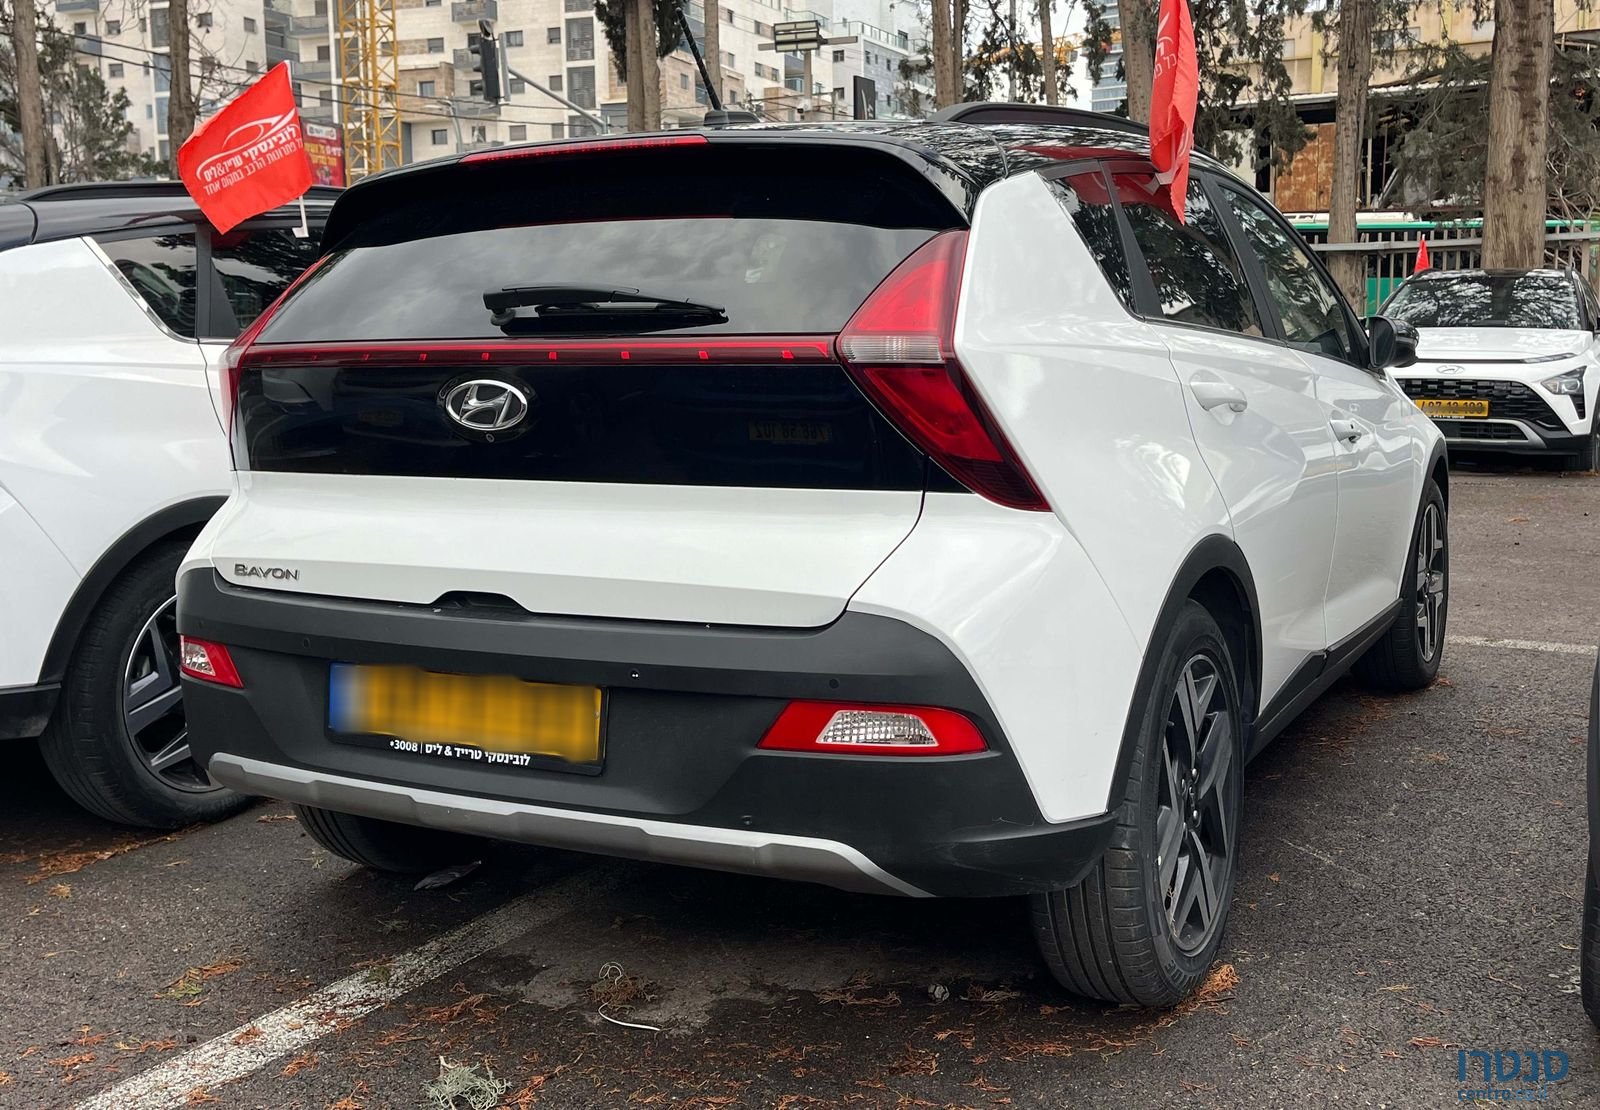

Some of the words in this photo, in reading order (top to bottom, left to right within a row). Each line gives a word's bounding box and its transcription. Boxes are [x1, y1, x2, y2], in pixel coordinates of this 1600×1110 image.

[242, 125, 297, 161] לובינסקי
[267, 142, 297, 162] פתרונות
[244, 157, 267, 176] הרכב
[203, 179, 222, 196] אחד
[221, 169, 245, 189] במקום
[234, 563, 299, 580] BAYON
[425, 743, 442, 755] ליס
[444, 746, 453, 756] &
[454, 747, 482, 760] טרייד
[484, 751, 531, 766] לובינסקי
